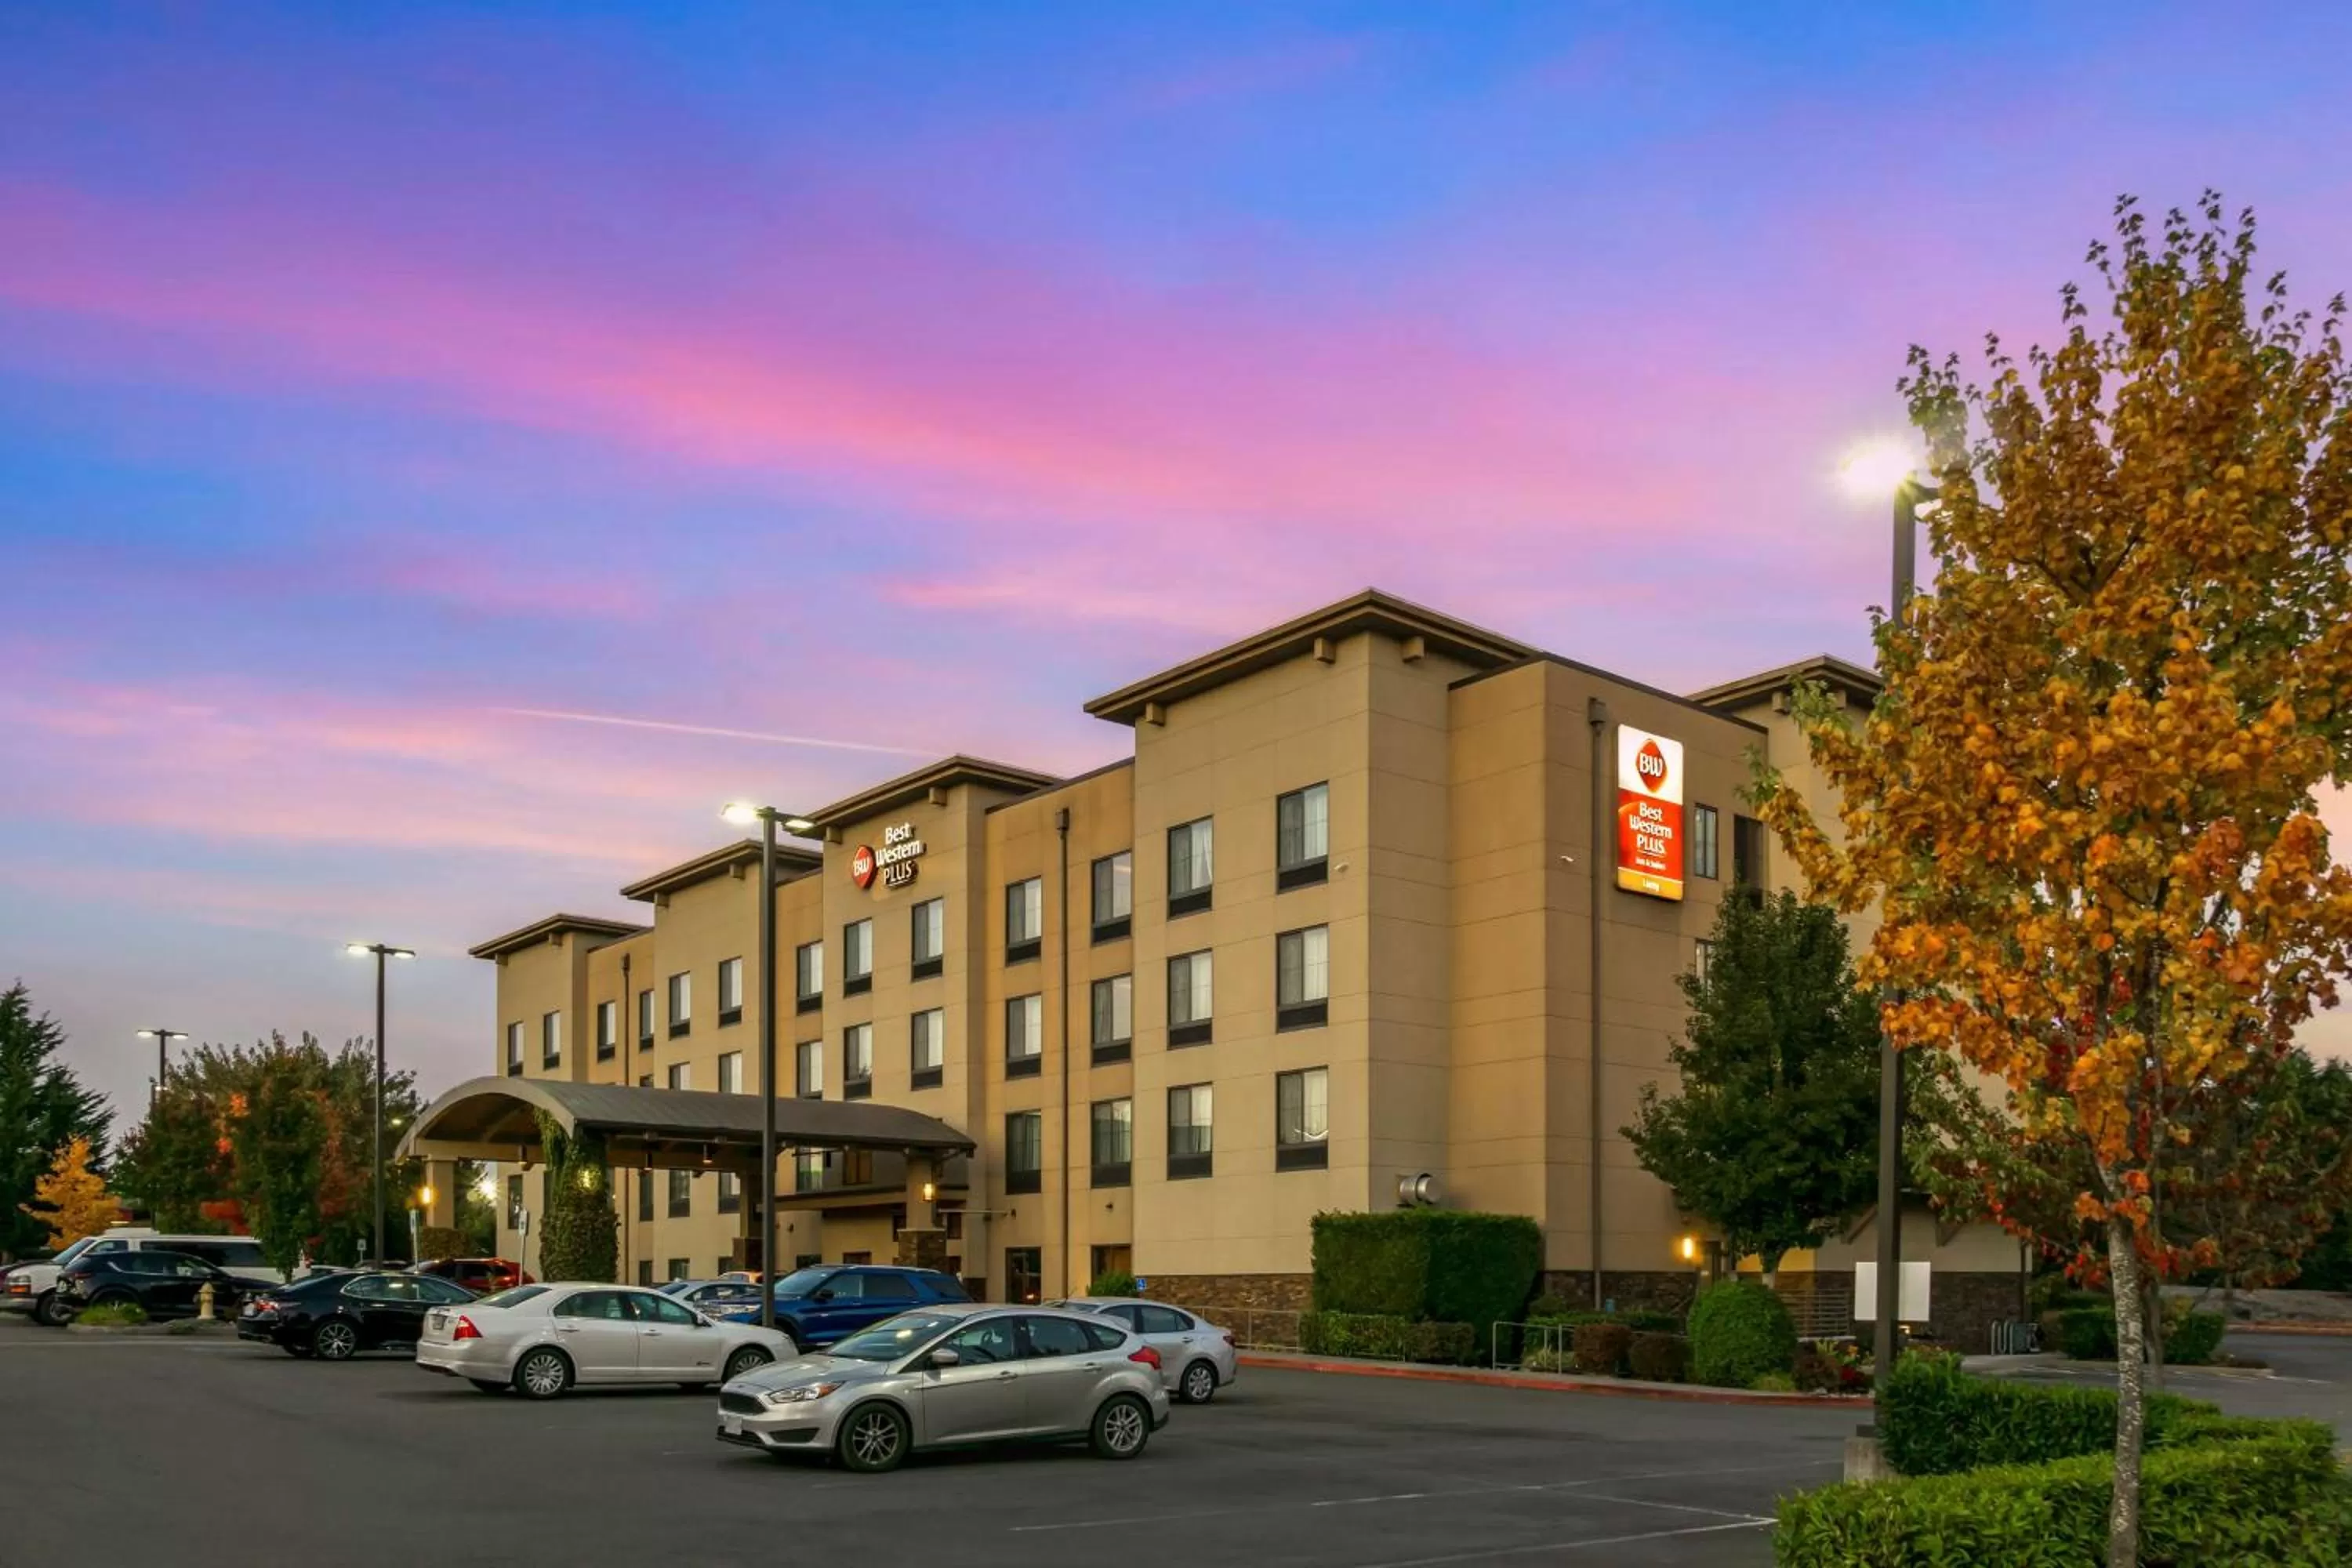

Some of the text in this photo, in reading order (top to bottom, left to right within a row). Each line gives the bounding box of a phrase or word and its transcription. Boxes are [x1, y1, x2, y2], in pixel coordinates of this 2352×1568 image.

[1639, 753, 1663, 778] BW
[1639, 802, 1662, 822] Best
[885, 822, 910, 845] Best
[1629, 815, 1673, 839] Western
[876, 840, 920, 867] Western
[1636, 834, 1666, 854] PLUS
[853, 856, 869, 877] BW
[884, 861, 912, 885] PLUS
